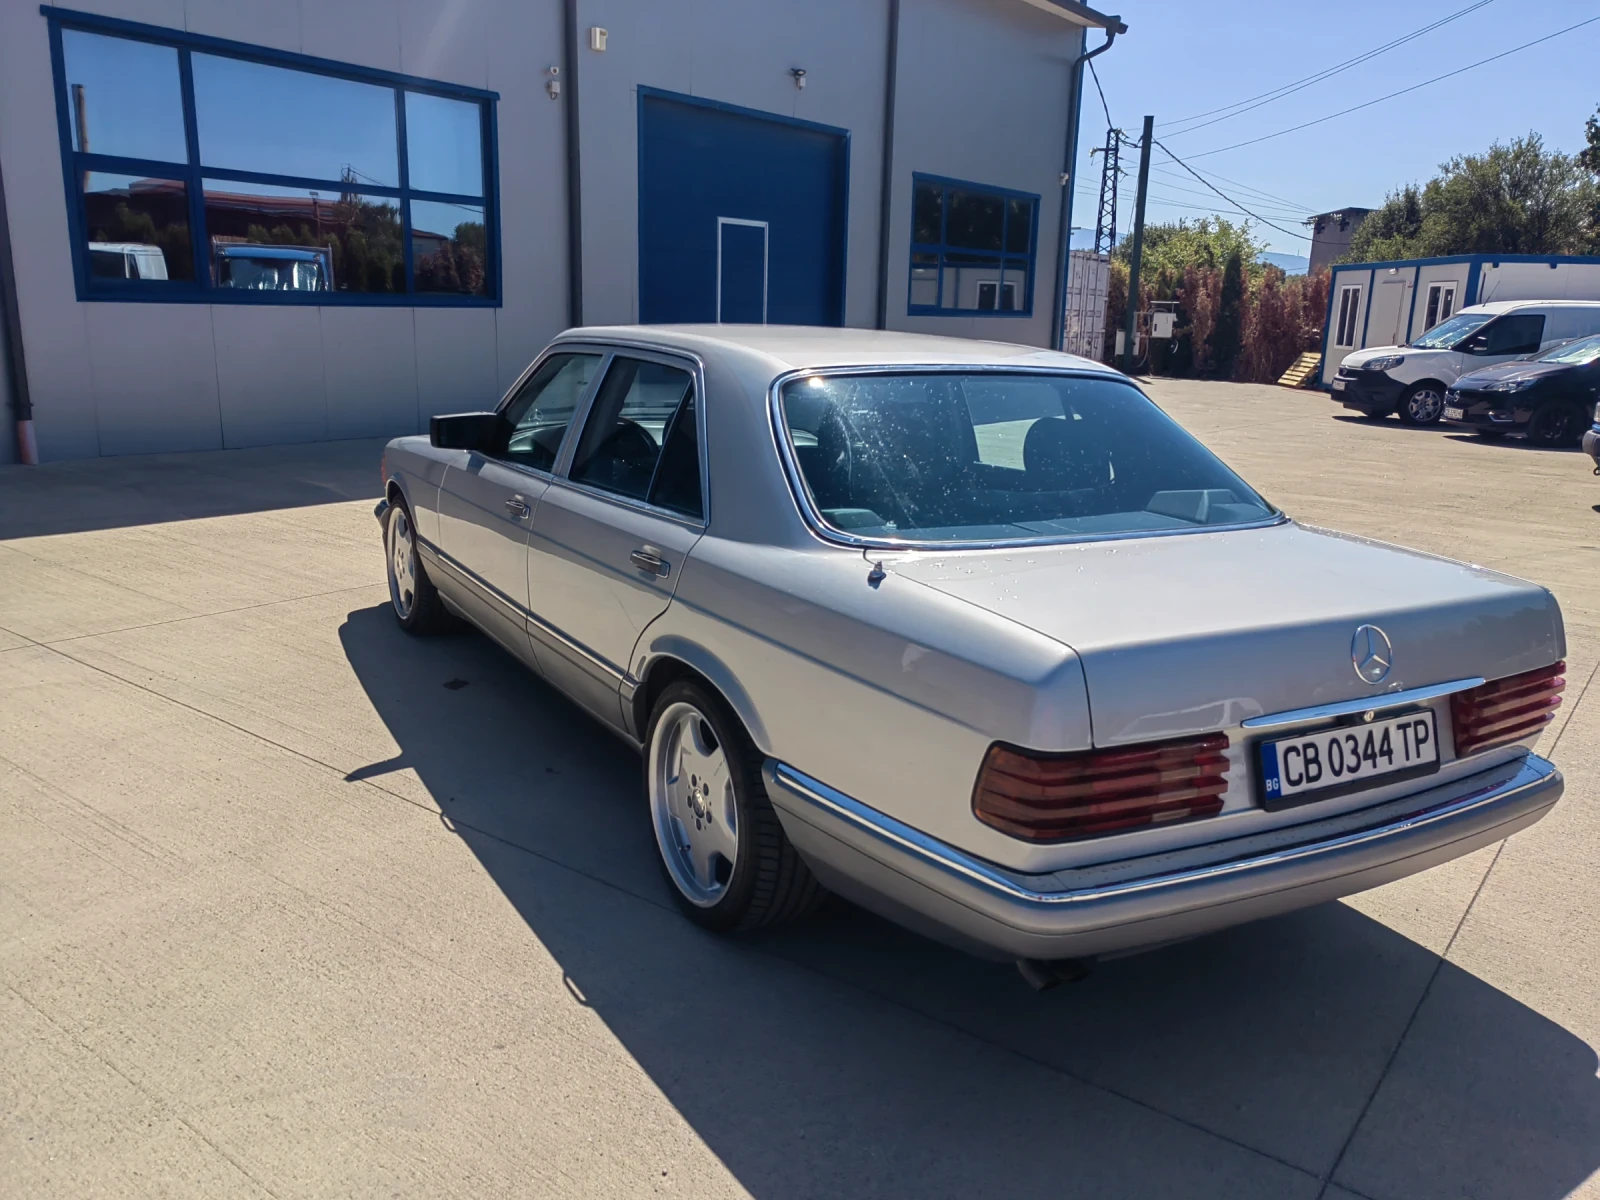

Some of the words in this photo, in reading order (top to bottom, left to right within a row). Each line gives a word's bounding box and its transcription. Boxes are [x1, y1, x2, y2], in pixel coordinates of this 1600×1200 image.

[1283, 742, 1322, 787] CB
[1328, 726, 1393, 777] 0344
[1397, 719, 1429, 761] TP
[1265, 778, 1279, 792] BG
